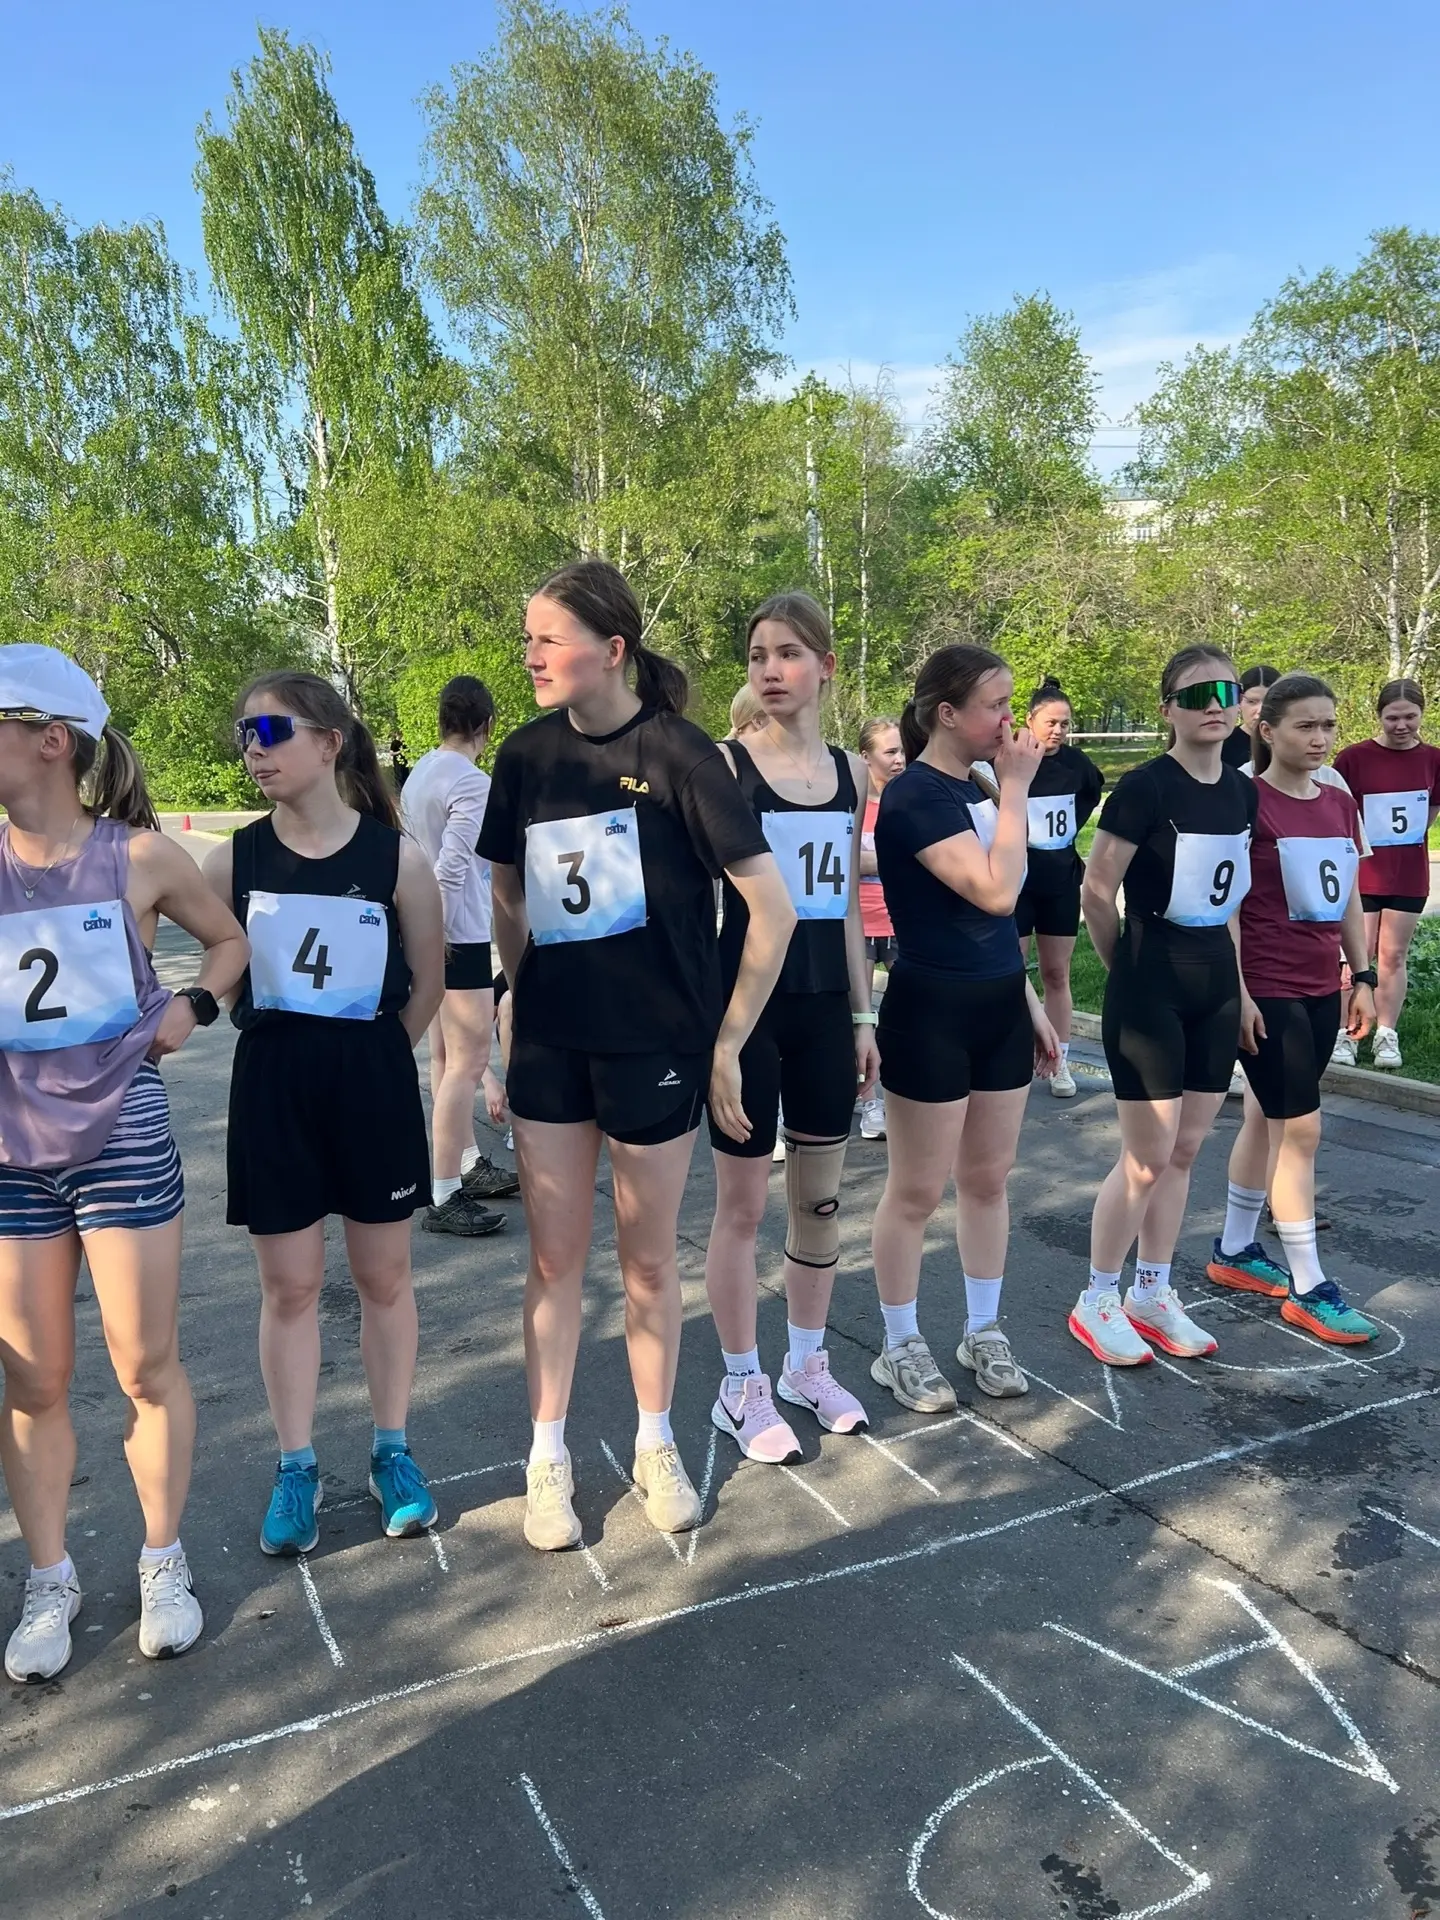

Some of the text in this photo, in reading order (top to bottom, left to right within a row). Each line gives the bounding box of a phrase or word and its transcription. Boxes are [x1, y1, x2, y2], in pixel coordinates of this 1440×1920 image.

[620, 776, 650, 794] FILA
[1045, 809, 1068, 837] 18
[1392, 806, 1408, 834] 5
[557, 850, 591, 915] 3
[798, 841, 845, 896] 14
[1209, 859, 1235, 907] 9
[1319, 859, 1340, 904] 6
[292, 927, 333, 990] 4
[18, 947, 68, 1023] 2
